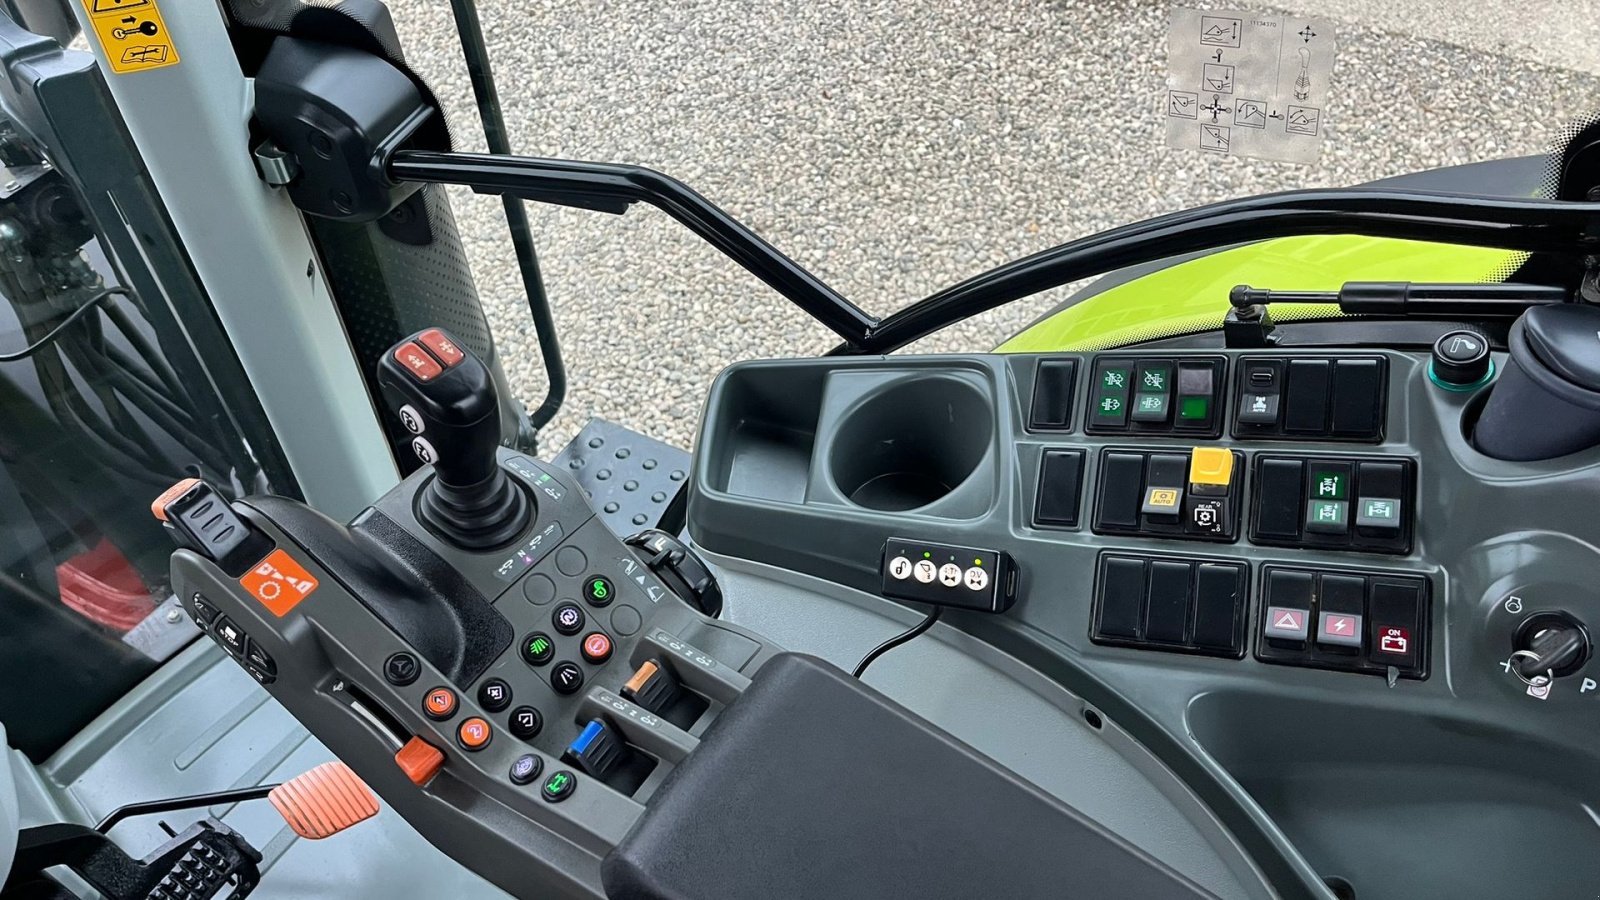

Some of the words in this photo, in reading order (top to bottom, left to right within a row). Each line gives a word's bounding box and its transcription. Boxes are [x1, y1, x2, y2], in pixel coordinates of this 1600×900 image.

[415, 442, 430, 461] F4
[517, 549, 527, 558] N
[219, 628, 239, 647] STOP
[1387, 628, 1401, 636] ON
[1580, 677, 1597, 693] P
